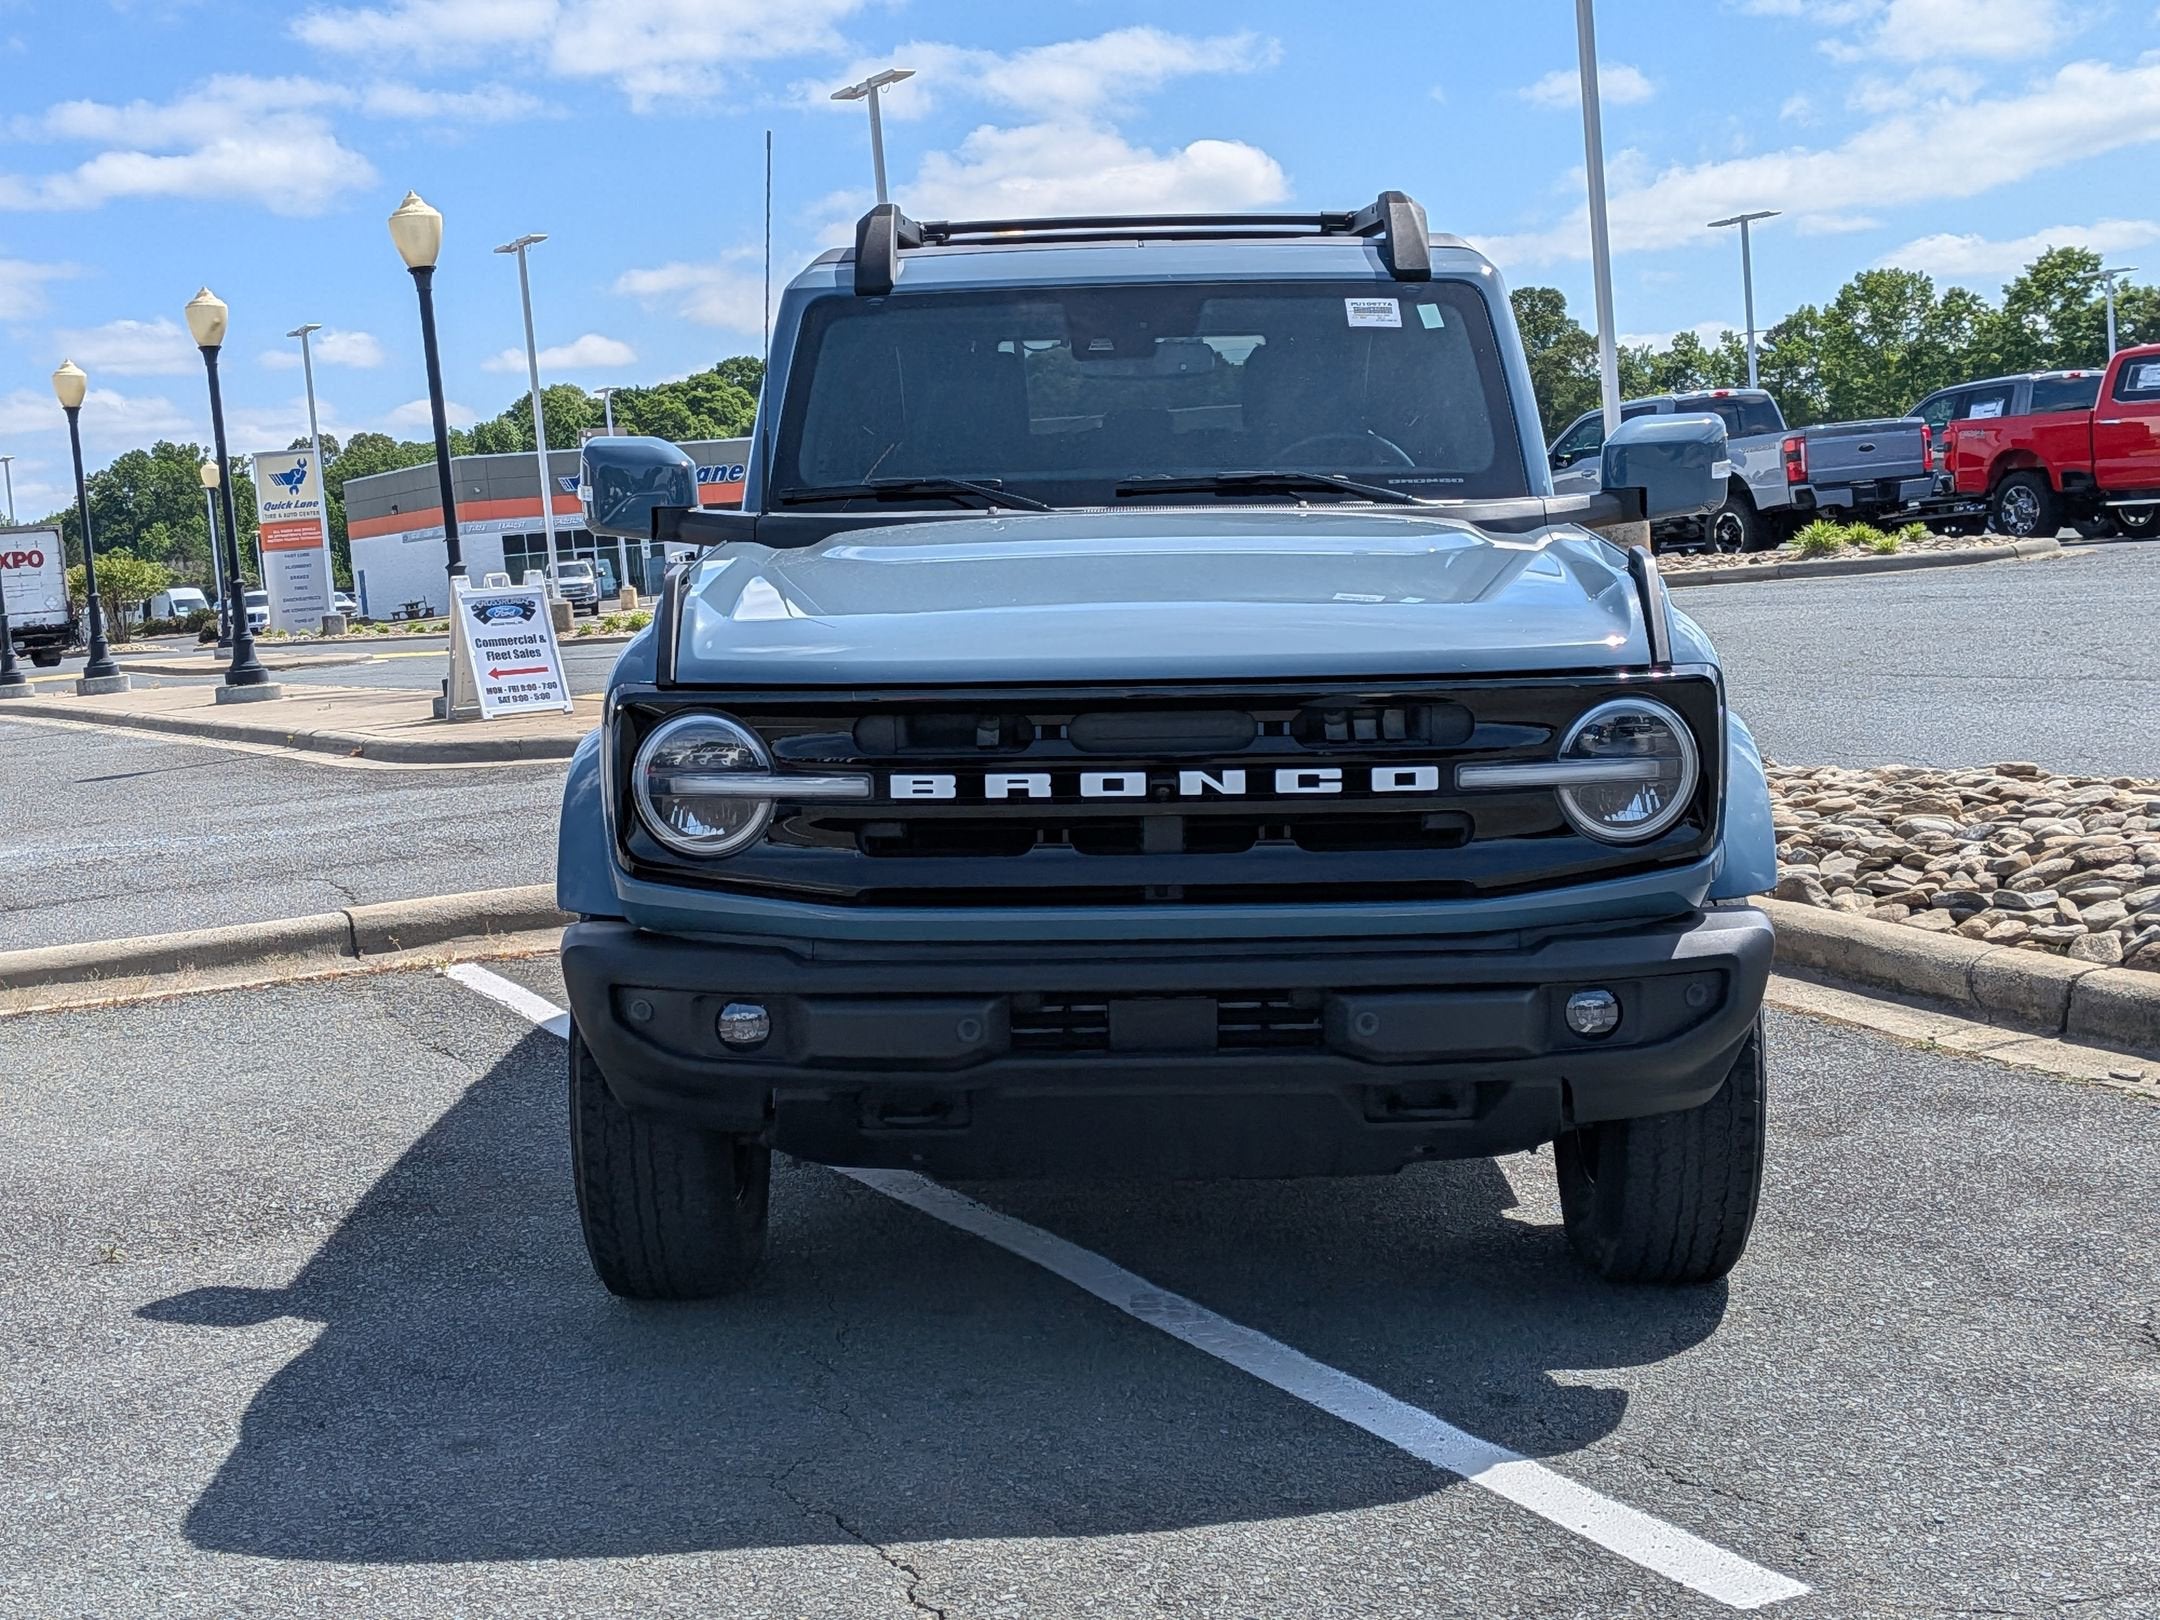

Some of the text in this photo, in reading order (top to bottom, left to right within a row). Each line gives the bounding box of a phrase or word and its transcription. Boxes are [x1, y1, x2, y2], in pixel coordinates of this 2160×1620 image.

[264, 499, 319, 511] Quick Lane
[0, 550, 44, 569] XPO
[490, 606, 518, 617] Ford
[475, 634, 547, 648] Commercial &
[486, 648, 542, 661] Fleet Sales
[508, 685, 520, 693] FRI
[542, 681, 558, 690] 7:00
[498, 696, 510, 704] SAT
[889, 765, 1440, 799] BRONCO
